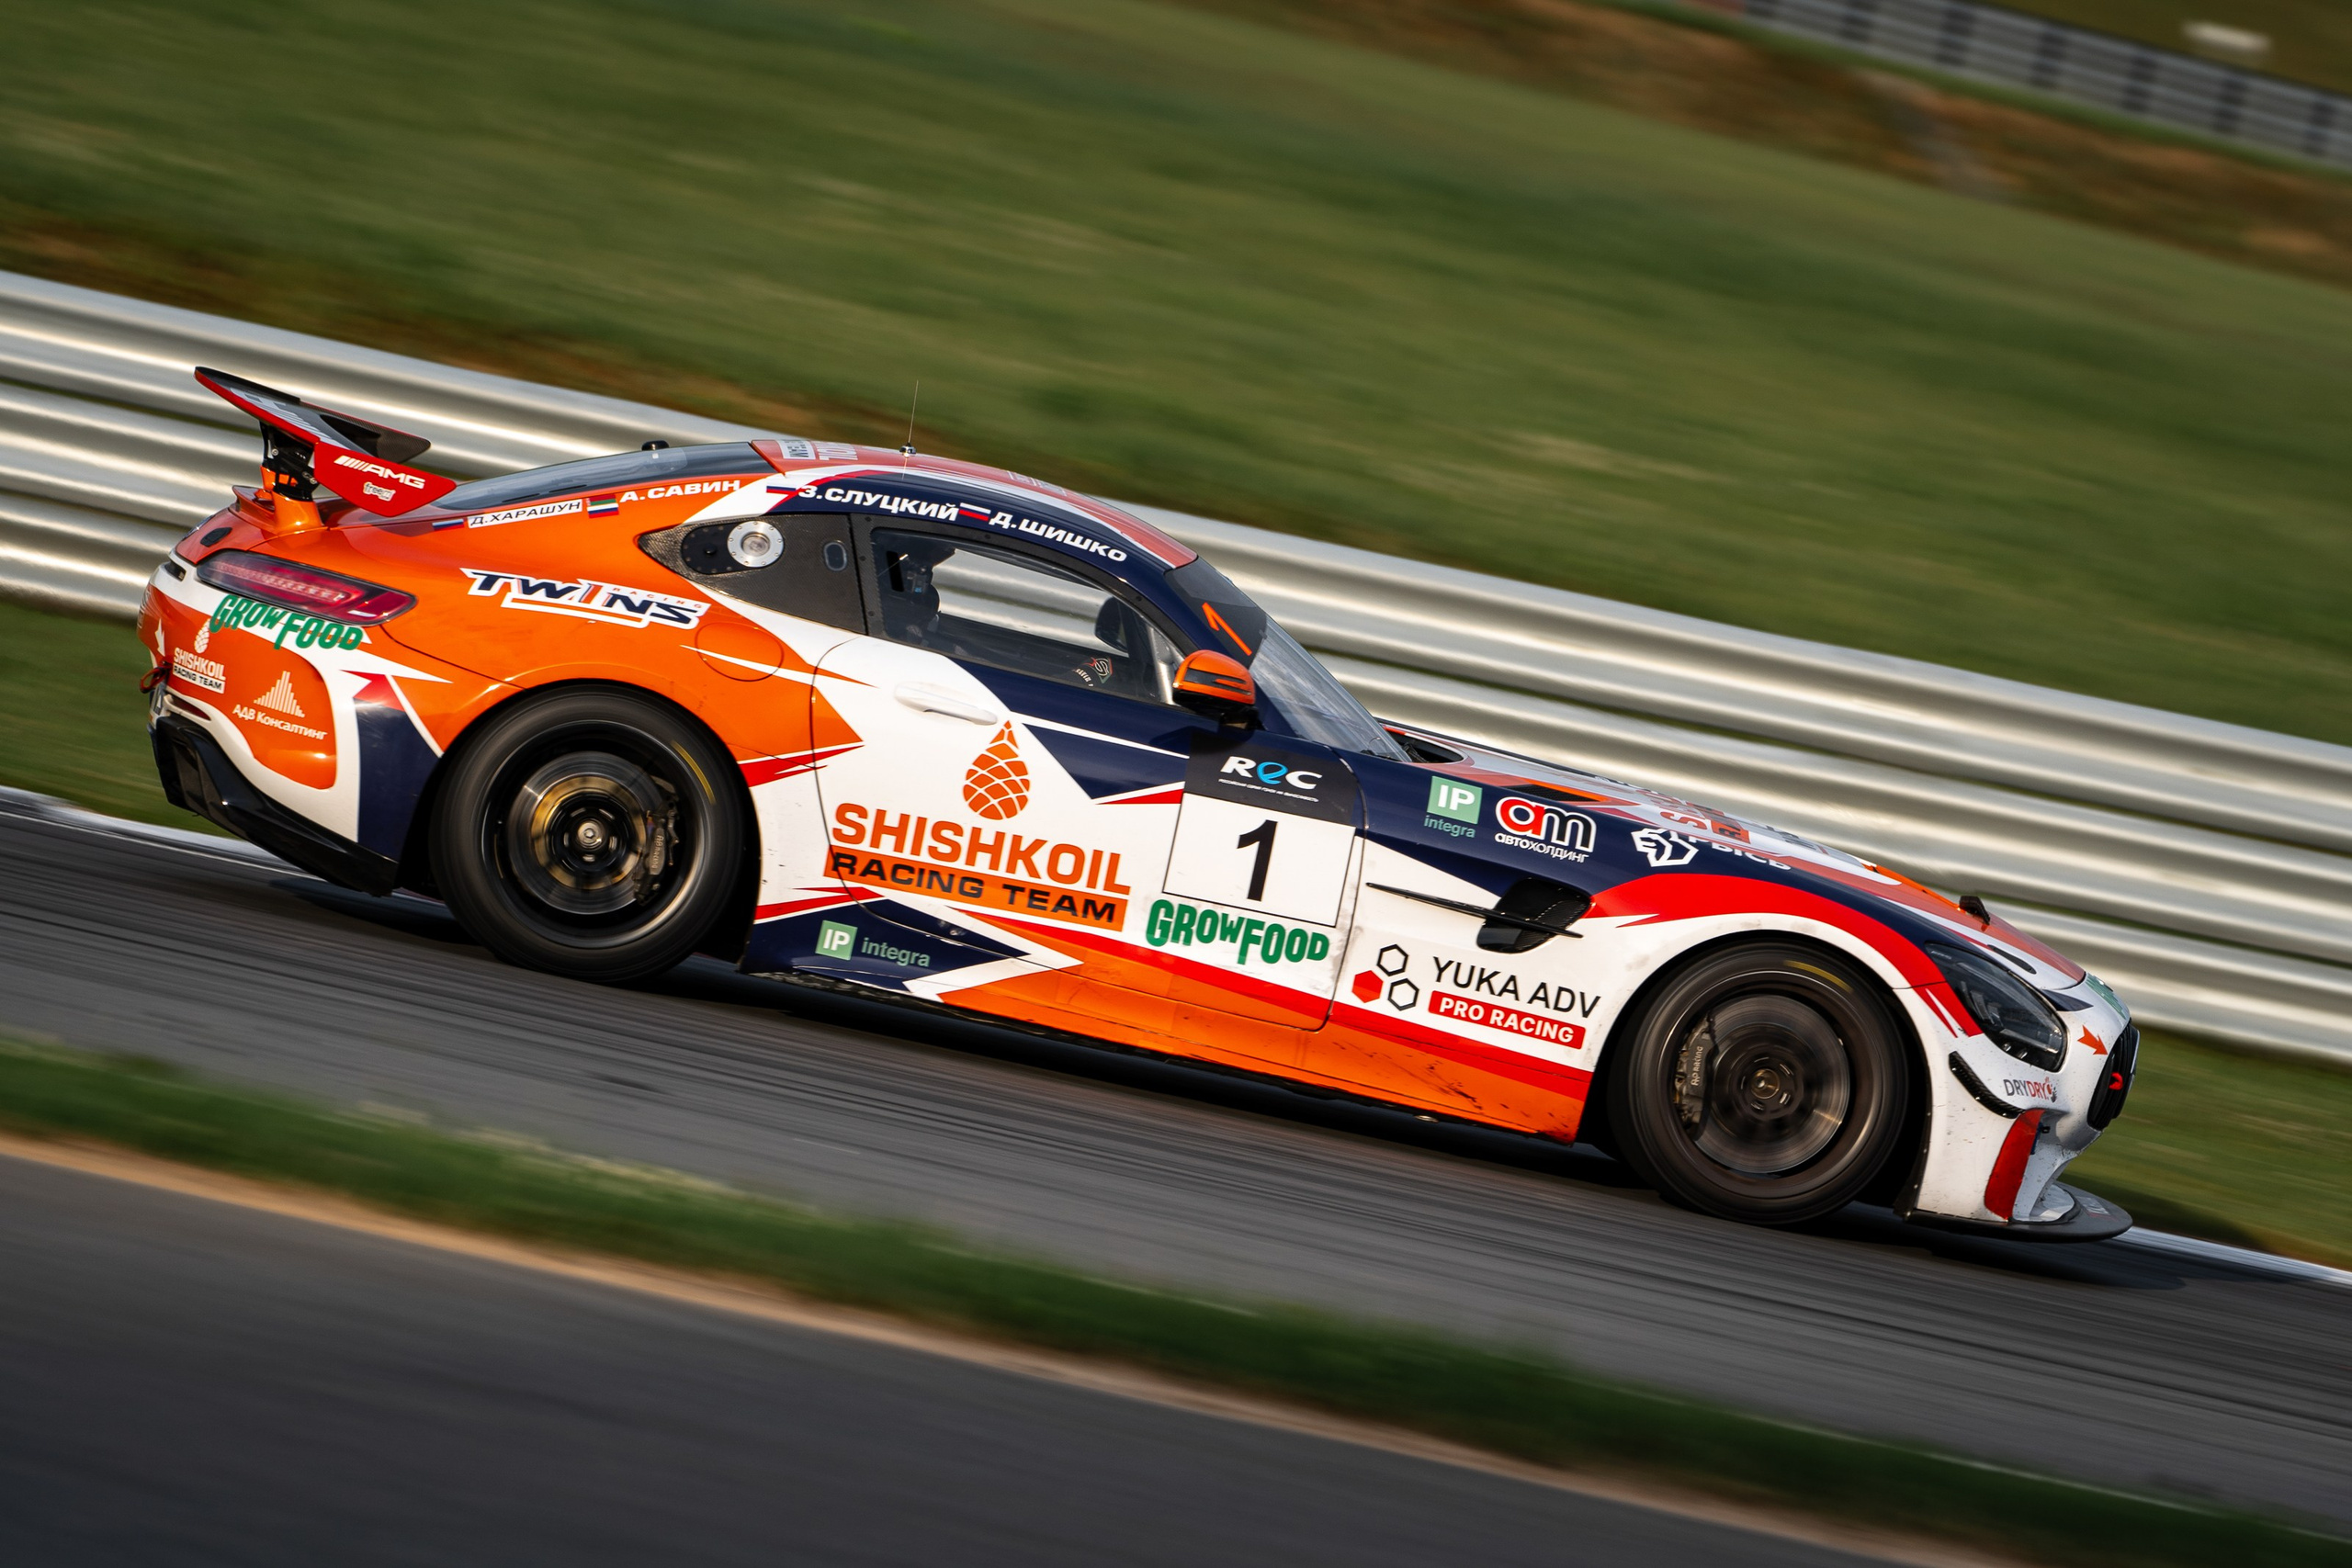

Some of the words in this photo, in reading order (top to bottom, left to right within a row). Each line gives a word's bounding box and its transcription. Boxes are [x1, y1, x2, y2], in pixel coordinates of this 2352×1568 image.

[620, 480, 740, 502] А.САВИН
[798, 484, 959, 522] З.СЛУЦКИЙ
[469, 502, 581, 526] Д.ХАРАШУН
[989, 511, 1127, 562] Д.ШИШКО
[613, 587, 702, 608] RACING
[209, 594, 363, 650] GROWFOOD
[174, 647, 226, 681] SHISHKOIL
[174, 665, 196, 682] RACING
[198, 676, 222, 690] TEAM
[232, 704, 256, 720] АДВ
[256, 712, 328, 739] Консалтинг
[1438, 785, 1476, 815] IP
[1424, 814, 1476, 838] integra
[832, 803, 1130, 896] SHISHKOIL
[1237, 819, 1278, 901] 1
[1495, 834, 1589, 863] автохолдинг
[831, 852, 984, 899] RACING
[1001, 884, 1117, 923] TEAM
[823, 929, 851, 952] IP
[861, 937, 931, 967] integra
[1145, 899, 1330, 965] GROWFOOD
[1432, 956, 1520, 1001] YUKA
[1526, 982, 1601, 1019] ADV
[1440, 997, 1486, 1021] PRO
[1488, 1009, 1575, 1043] RACING
[2003, 1078, 2047, 1100] DRYDRY
